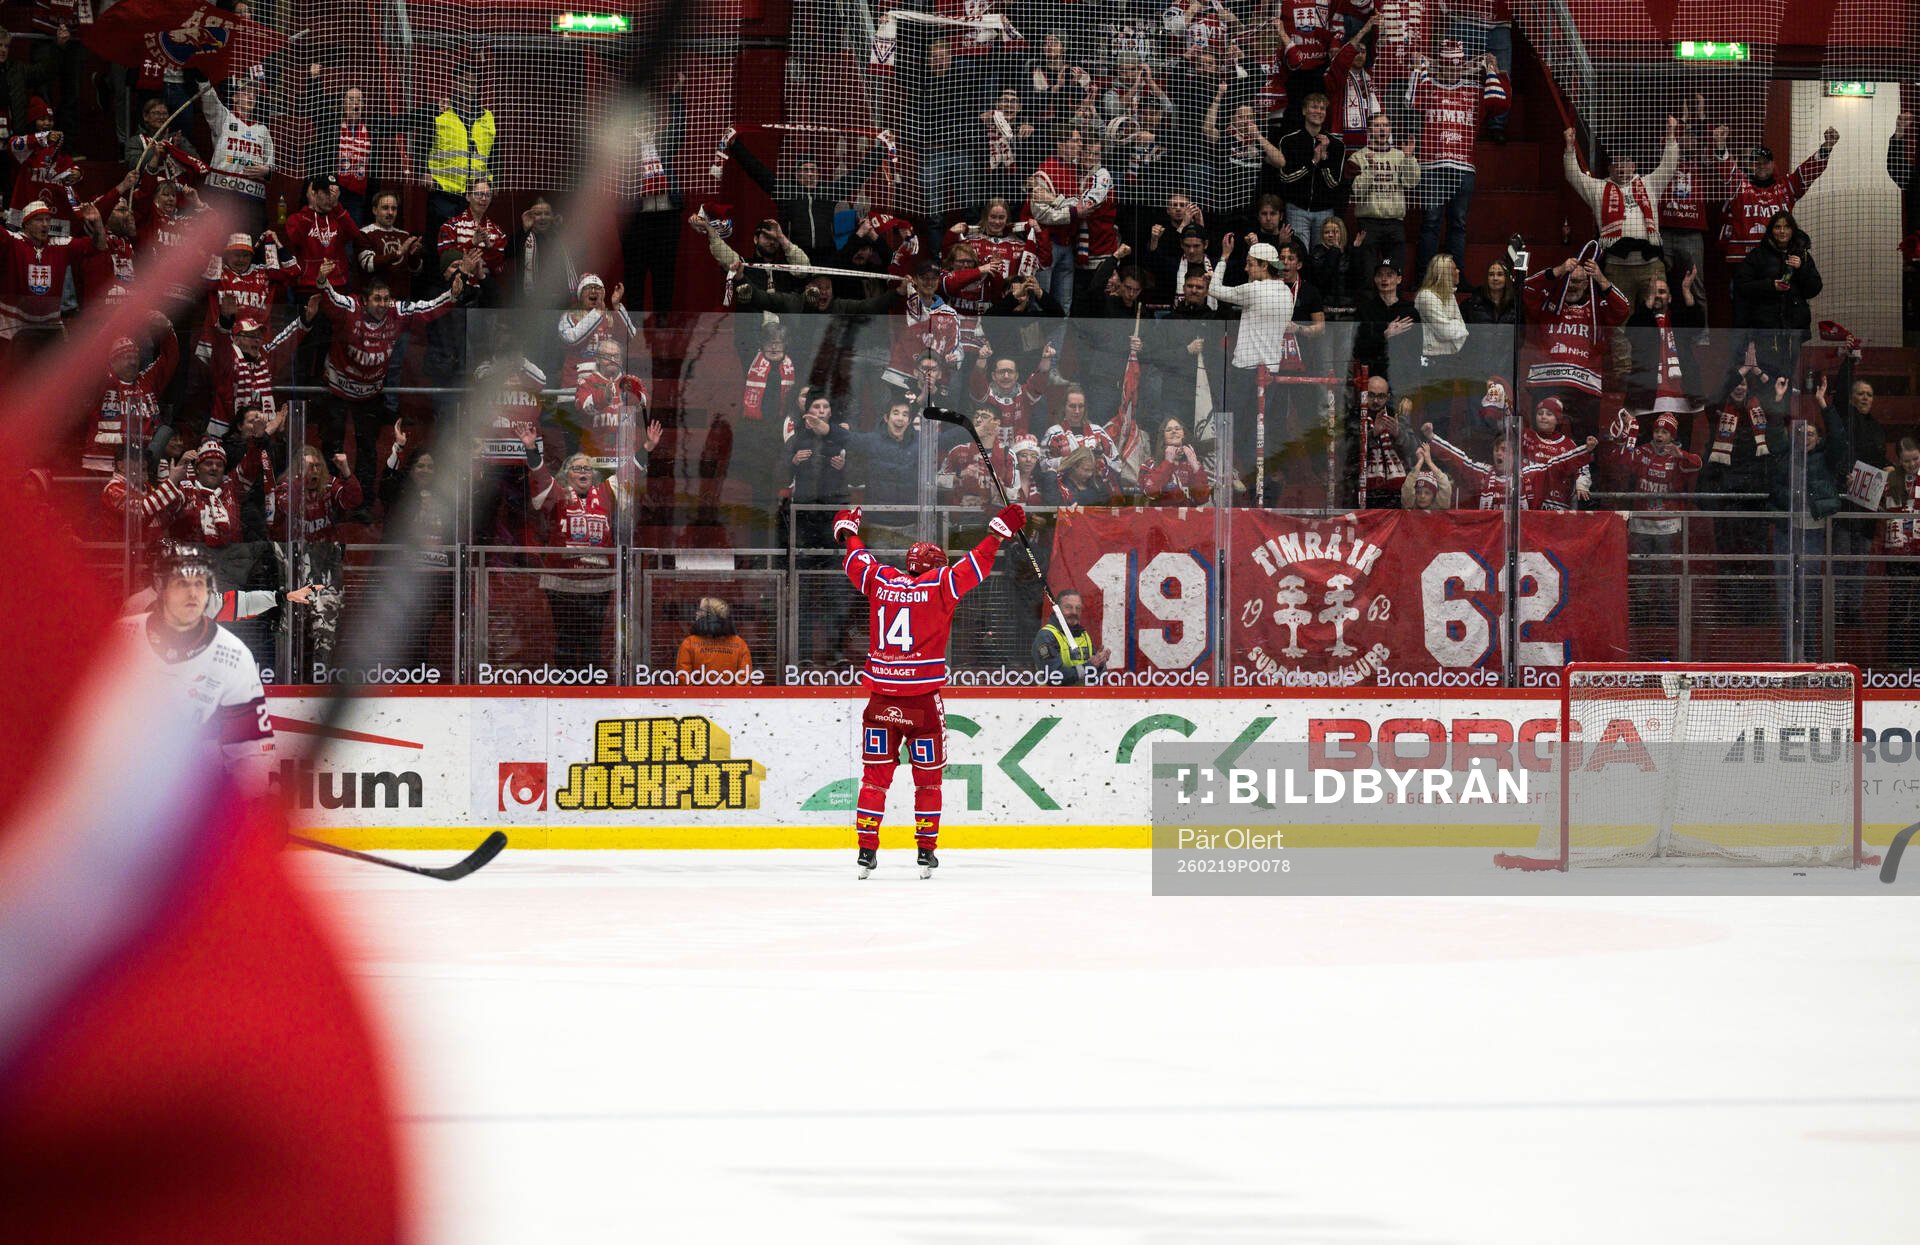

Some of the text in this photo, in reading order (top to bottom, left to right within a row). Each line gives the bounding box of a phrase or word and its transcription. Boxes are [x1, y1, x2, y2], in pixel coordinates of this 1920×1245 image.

[1567, 346, 1590, 359] NHC
[488, 444, 526, 454] BILBOLA
[1251, 526, 1383, 577] TIMRÅ IK
[877, 605, 914, 653] 14
[1087, 553, 1208, 669] 19
[1241, 598, 1264, 628] 19
[1367, 594, 1392, 622] 62
[1421, 552, 1564, 668] 62
[595, 716, 711, 763] EURO
[1308, 718, 1658, 772] BORGA
[556, 760, 753, 810] JACKPOT
